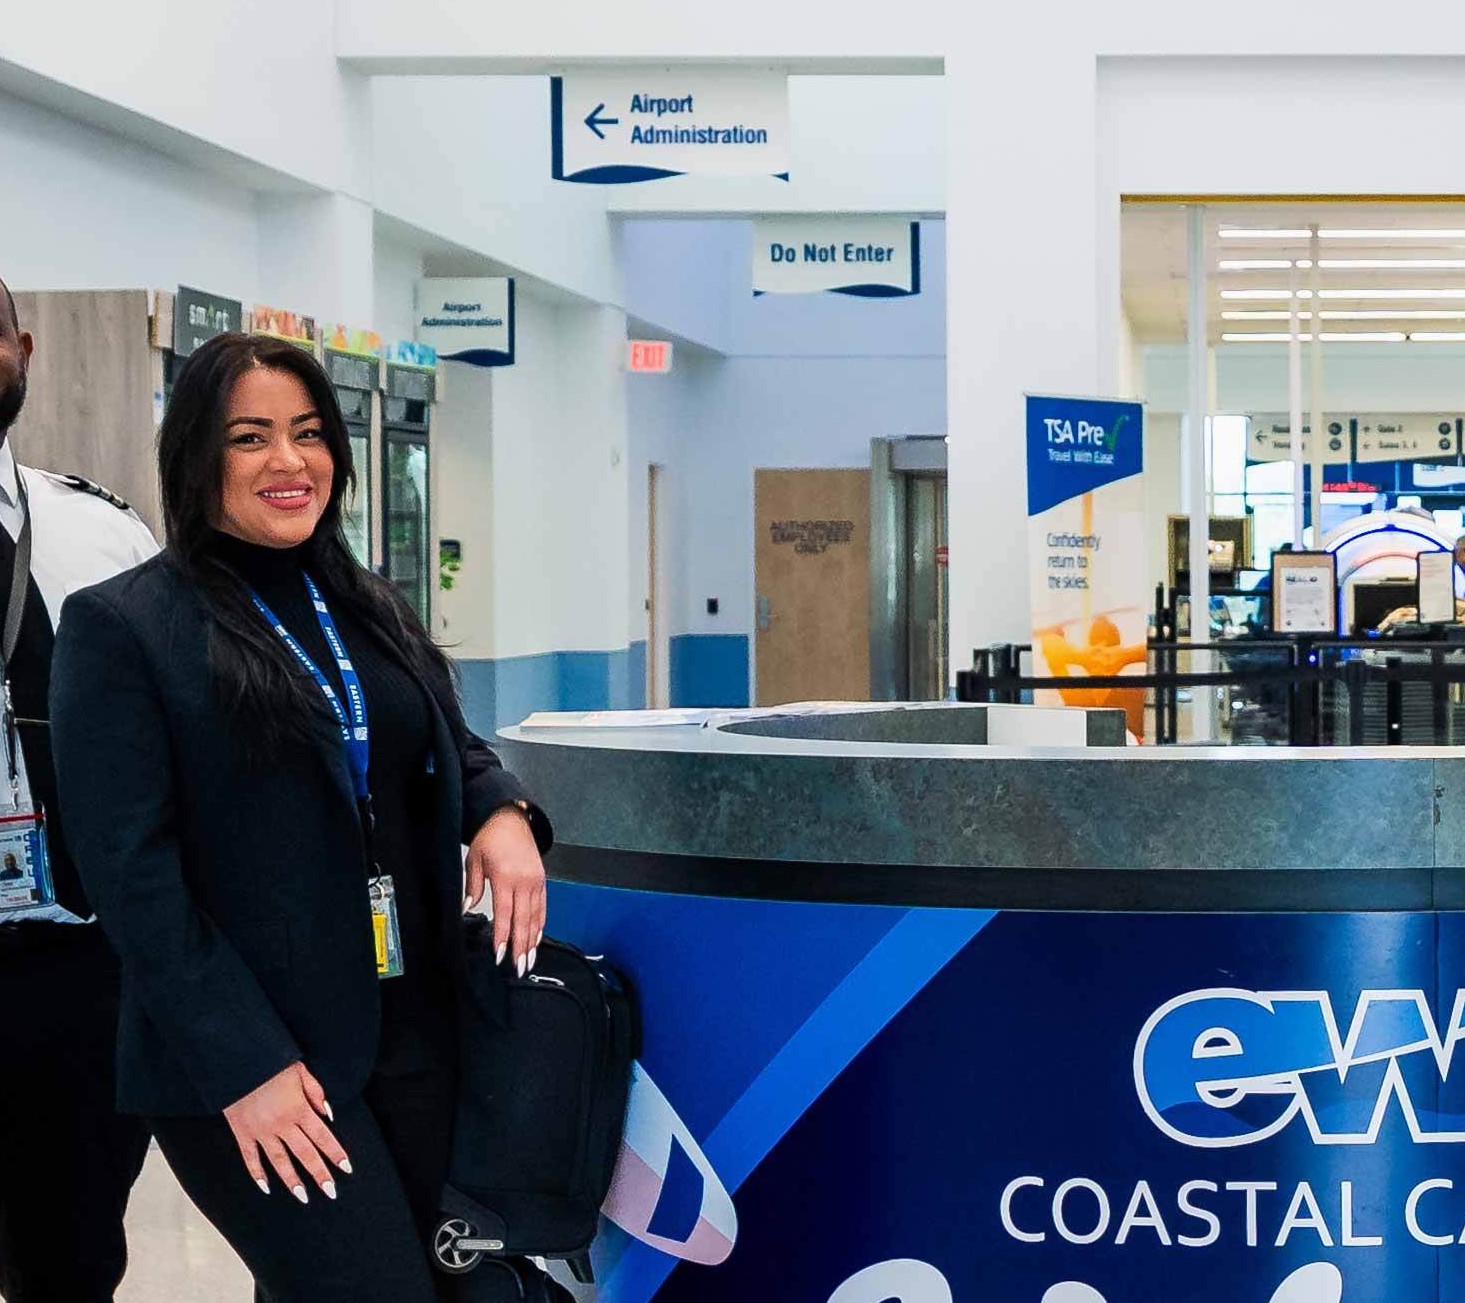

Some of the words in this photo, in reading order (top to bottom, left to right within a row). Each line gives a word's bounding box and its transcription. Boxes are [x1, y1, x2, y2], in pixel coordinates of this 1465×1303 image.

[630, 94, 694, 117] Airport
[630, 124, 768, 145] Administration
[770, 243, 796, 263] Do
[803, 243, 837, 263] Not
[843, 243, 895, 263] Enter
[442, 301, 482, 314] Airport
[421, 316, 503, 327] Administration
[631, 342, 665, 369] EXIT
[1043, 418, 1075, 445] TSA
[1077, 421, 1105, 446] Pre
[1047, 449, 1071, 462] Travel
[770, 520, 855, 532] AUTHORIZED
[1047, 532, 1102, 551] Confidently
[1048, 554, 1075, 568] return
[1076, 554, 1088, 568] to
[325, 626, 344, 658] EASTERN
[349, 684, 364, 723] EASTERN
[999, 1174, 1383, 1248] COASTAL
